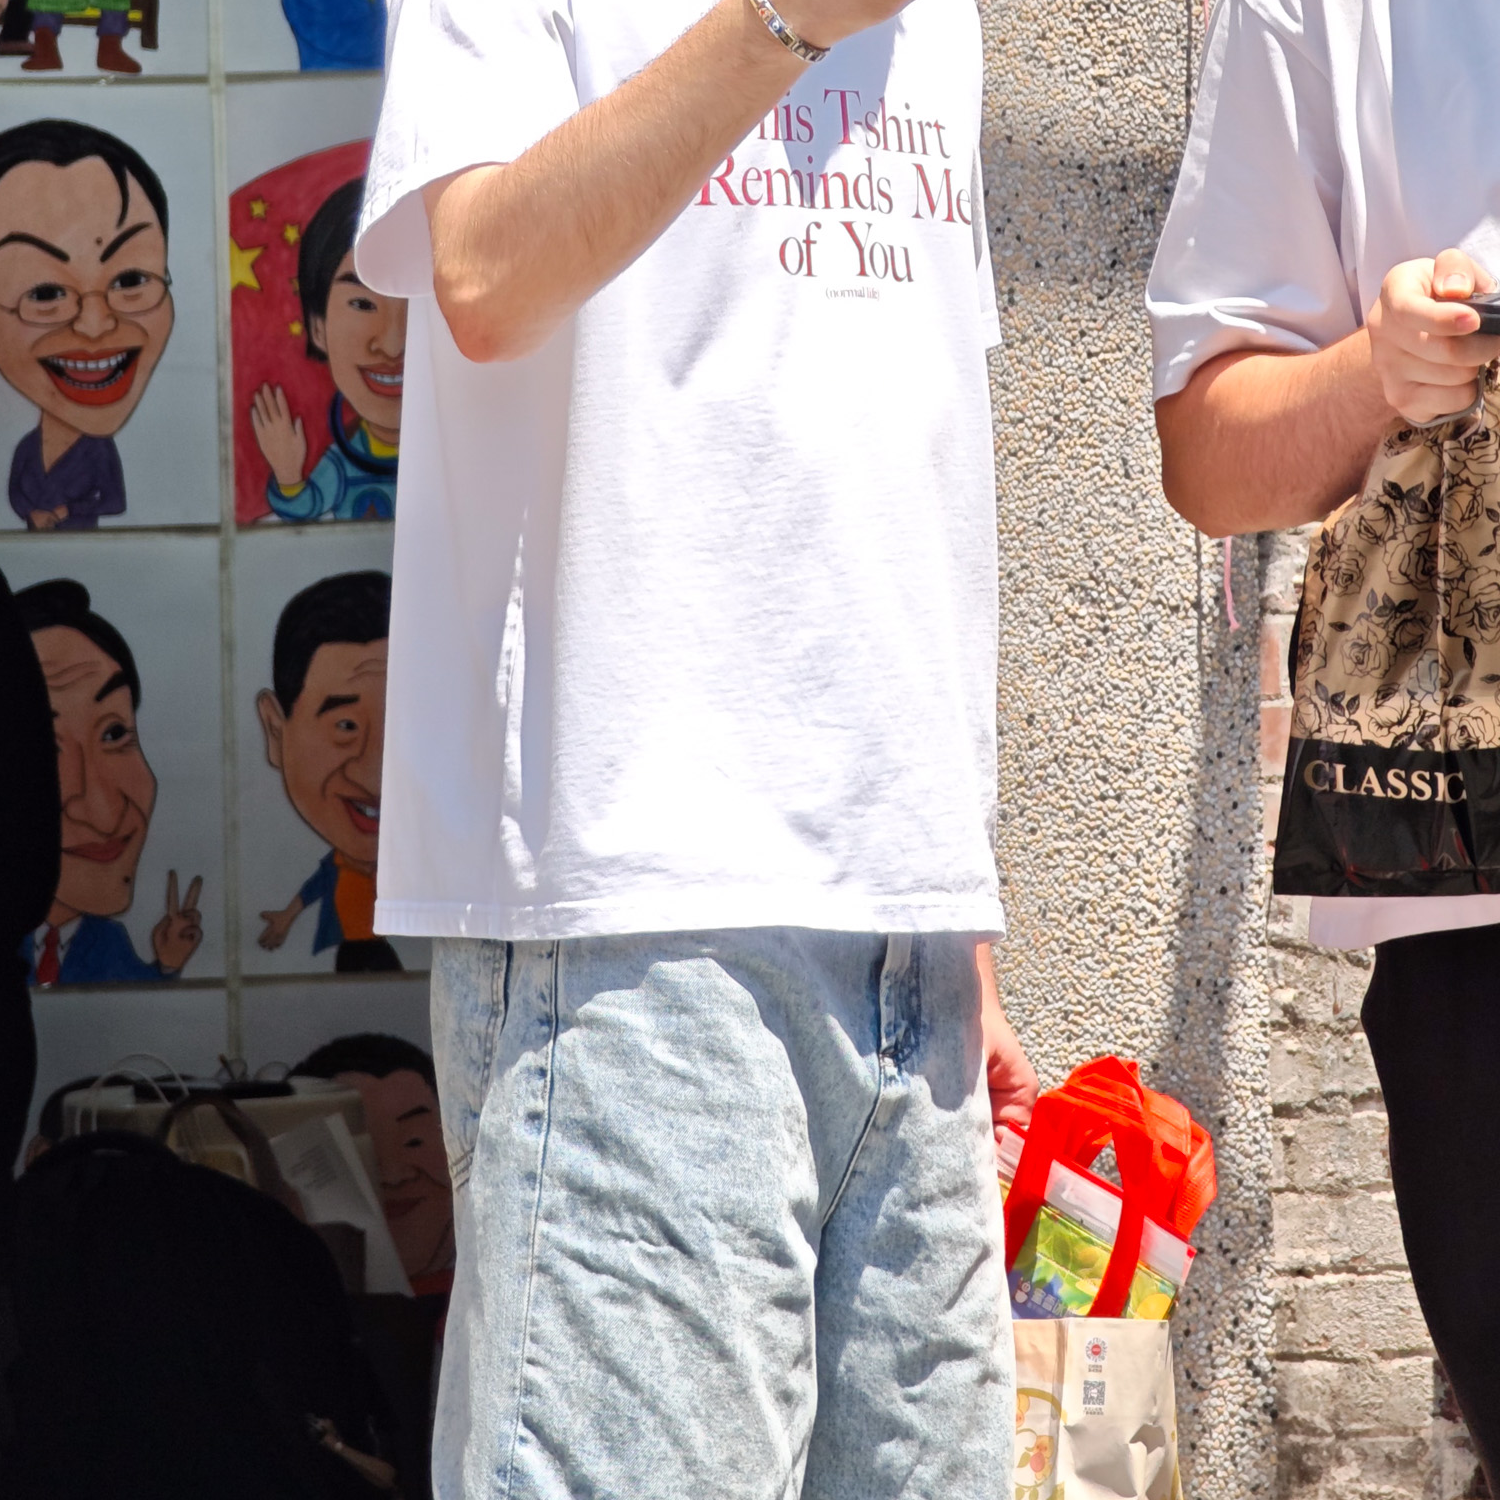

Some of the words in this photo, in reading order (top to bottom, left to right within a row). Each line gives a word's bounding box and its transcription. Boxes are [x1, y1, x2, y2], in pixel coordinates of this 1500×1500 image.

[823, 88, 952, 160] T-shirt
[695, 157, 894, 215] Reminds
[911, 162, 973, 226] Me
[778, 221, 823, 278] of
[839, 220, 915, 283] You
[1303, 759, 1468, 804] CLASSIC
